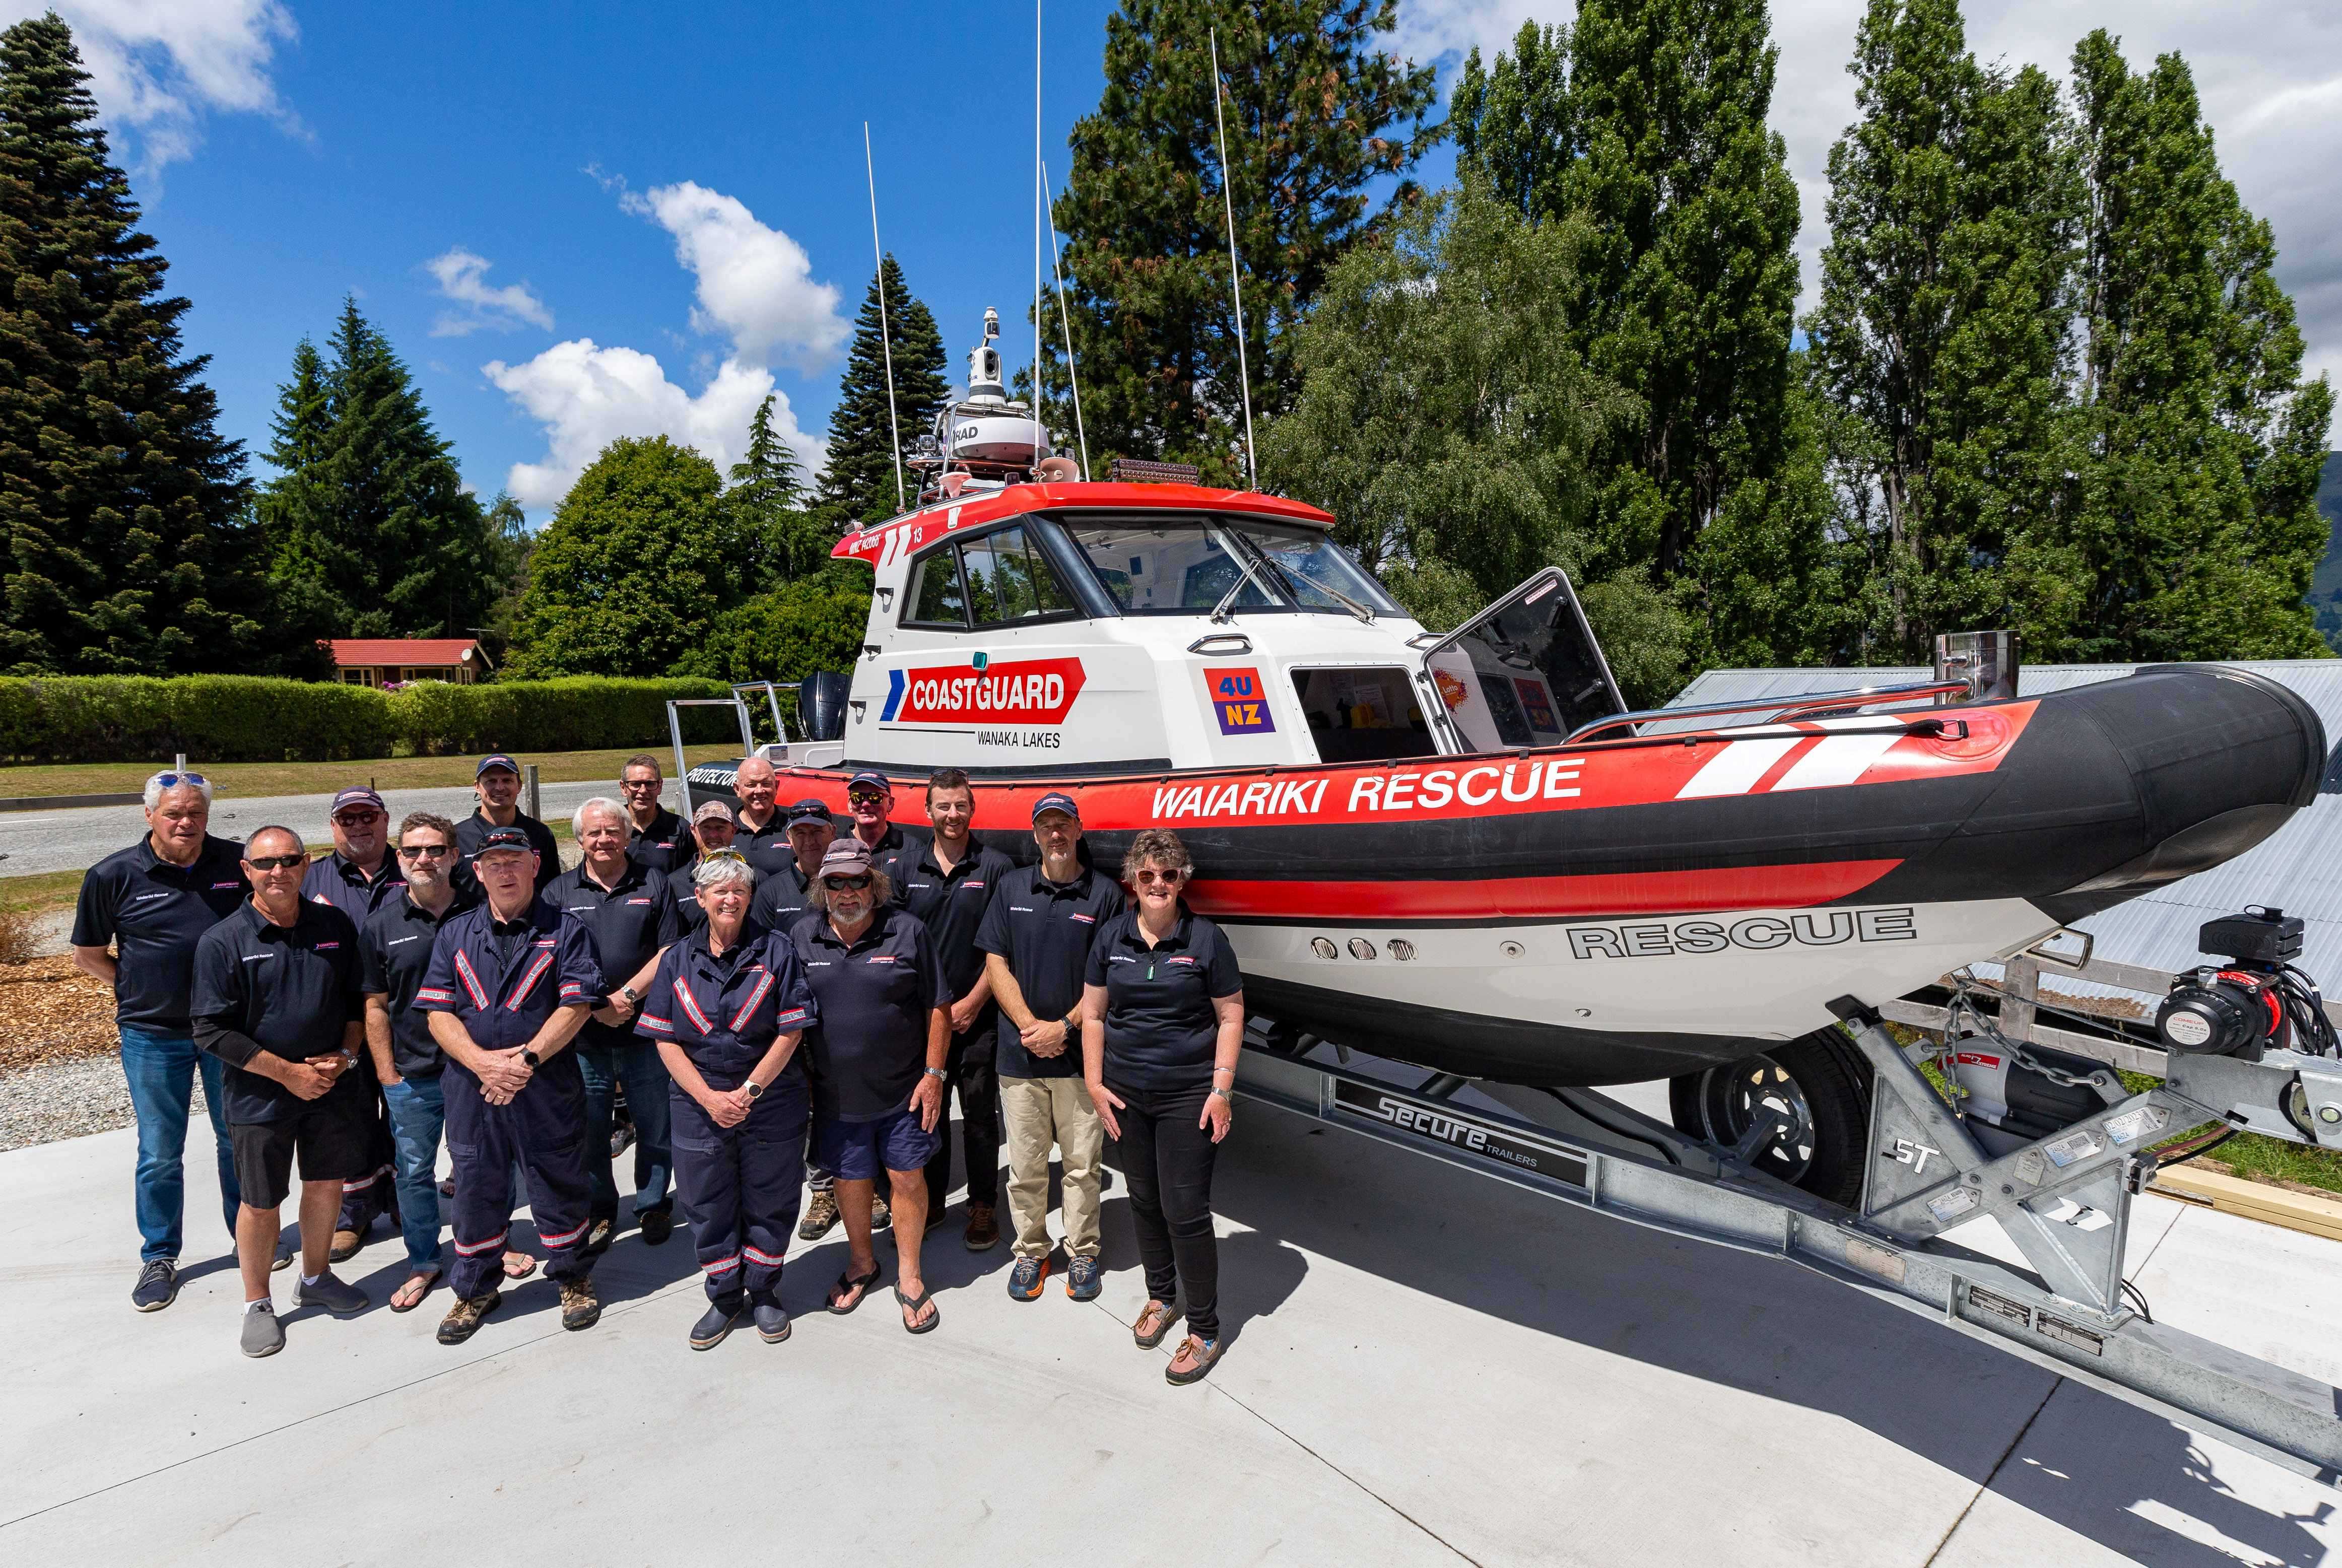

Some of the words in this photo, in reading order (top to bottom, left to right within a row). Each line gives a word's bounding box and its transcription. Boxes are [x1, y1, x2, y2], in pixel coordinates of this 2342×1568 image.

[953, 427, 978, 443] RAD
[849, 539, 862, 555] MNZ
[861, 533, 881, 552] 142066
[913, 526, 922, 543] 13
[912, 673, 1064, 710] COASTGUARD
[1219, 676, 1252, 696] 4U
[1442, 685, 1458, 694] Lotto
[1226, 704, 1261, 726] NZ
[978, 731, 1018, 746] WANAKA
[1023, 732, 1060, 748] LAKES
[1151, 779, 1329, 819] WAIARIKI
[1348, 759, 1586, 812] RESCUE
[1565, 907, 1917, 960] RESCUE
[2104, 1111, 2143, 1130] 02/02/2023
[1486, 1143, 1537, 1167] TRAILERS
[1882, 1138, 1940, 1174] ST
